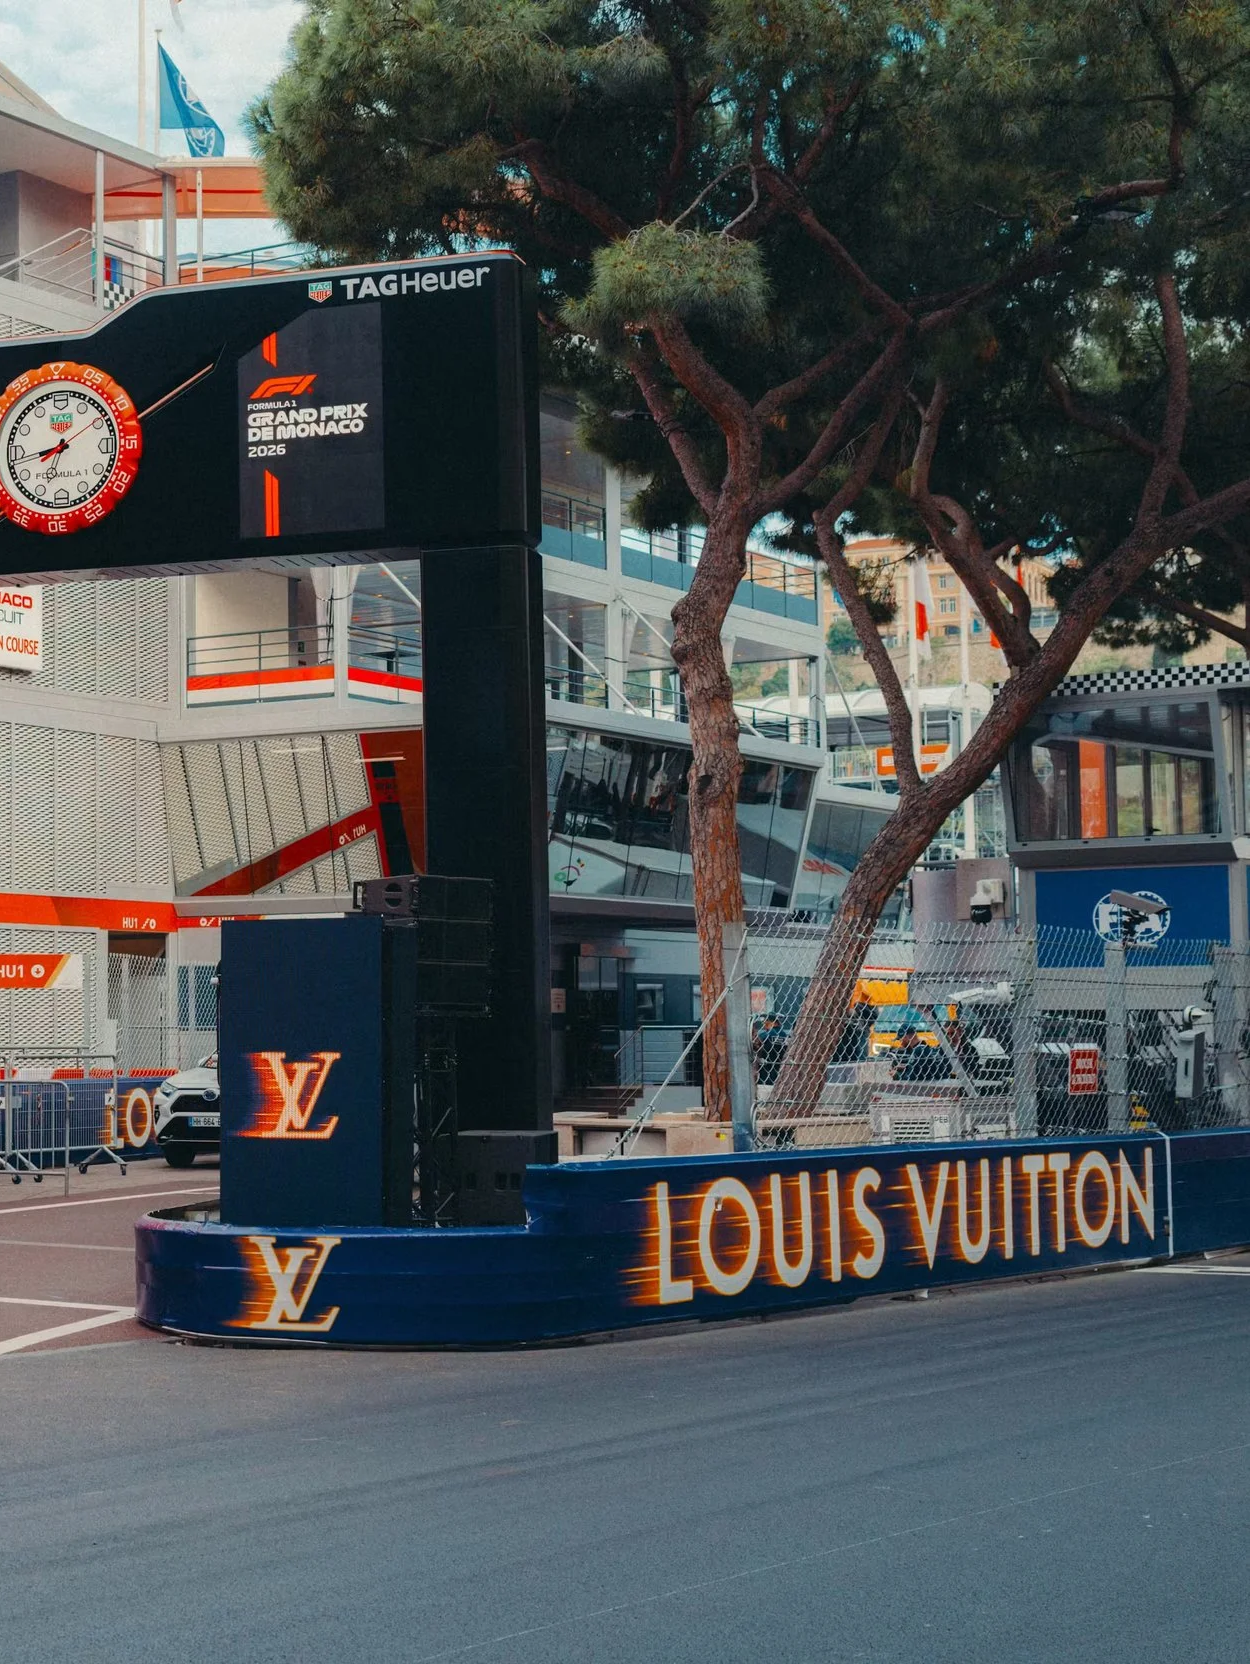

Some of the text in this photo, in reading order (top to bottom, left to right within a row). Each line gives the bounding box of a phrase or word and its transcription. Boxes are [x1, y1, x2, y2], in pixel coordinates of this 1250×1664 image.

[12, 375, 31, 392] 55
[83, 369, 104, 384] 05
[114, 395, 129, 411] 10
[247, 401, 291, 411] FORMULA
[52, 414, 71, 422] TAG
[247, 403, 368, 427] GRAND PRIX
[51, 421, 72, 432] HEUER
[248, 418, 364, 442] DE MONACO
[126, 434, 138, 449] 15
[248, 444, 286, 458] 2026
[36, 470, 81, 480] FOMULA
[113, 471, 131, 493] 20
[12, 511, 30, 527] 35
[84, 503, 106, 523] 25
[48, 520, 67, 533] 30
[6, 636, 39, 656] COURSE
[122, 917, 138, 928] HU1
[656, 1147, 1155, 1304] LOUIS VUITTON
